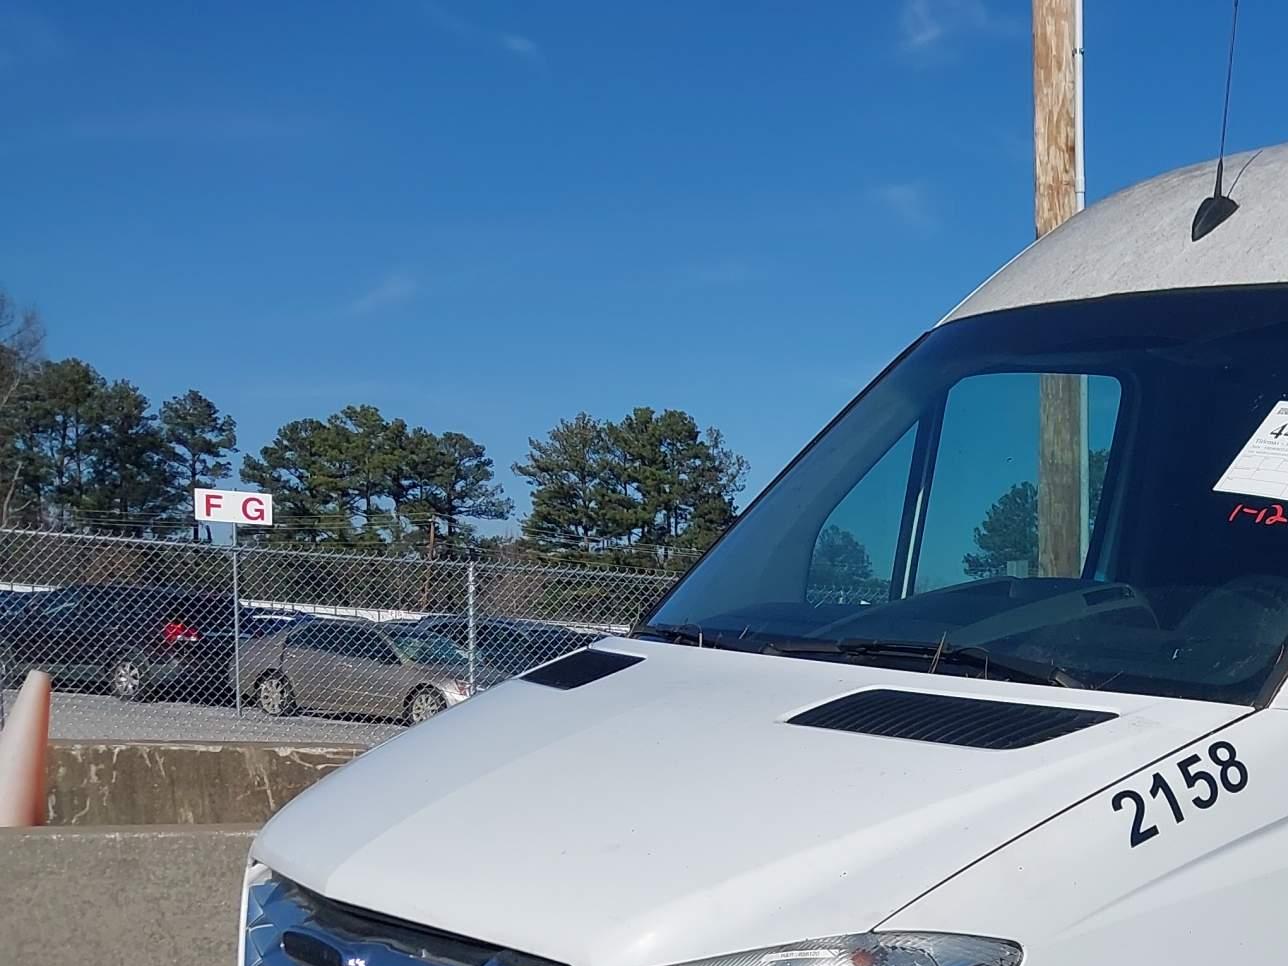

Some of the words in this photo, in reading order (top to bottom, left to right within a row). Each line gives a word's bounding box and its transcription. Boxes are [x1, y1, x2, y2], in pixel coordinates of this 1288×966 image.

[205, 494, 223, 517] F
[241, 497, 265, 521] G
[1228, 504, 1288, 525] 1-12
[1111, 740, 1249, 848] 2158
